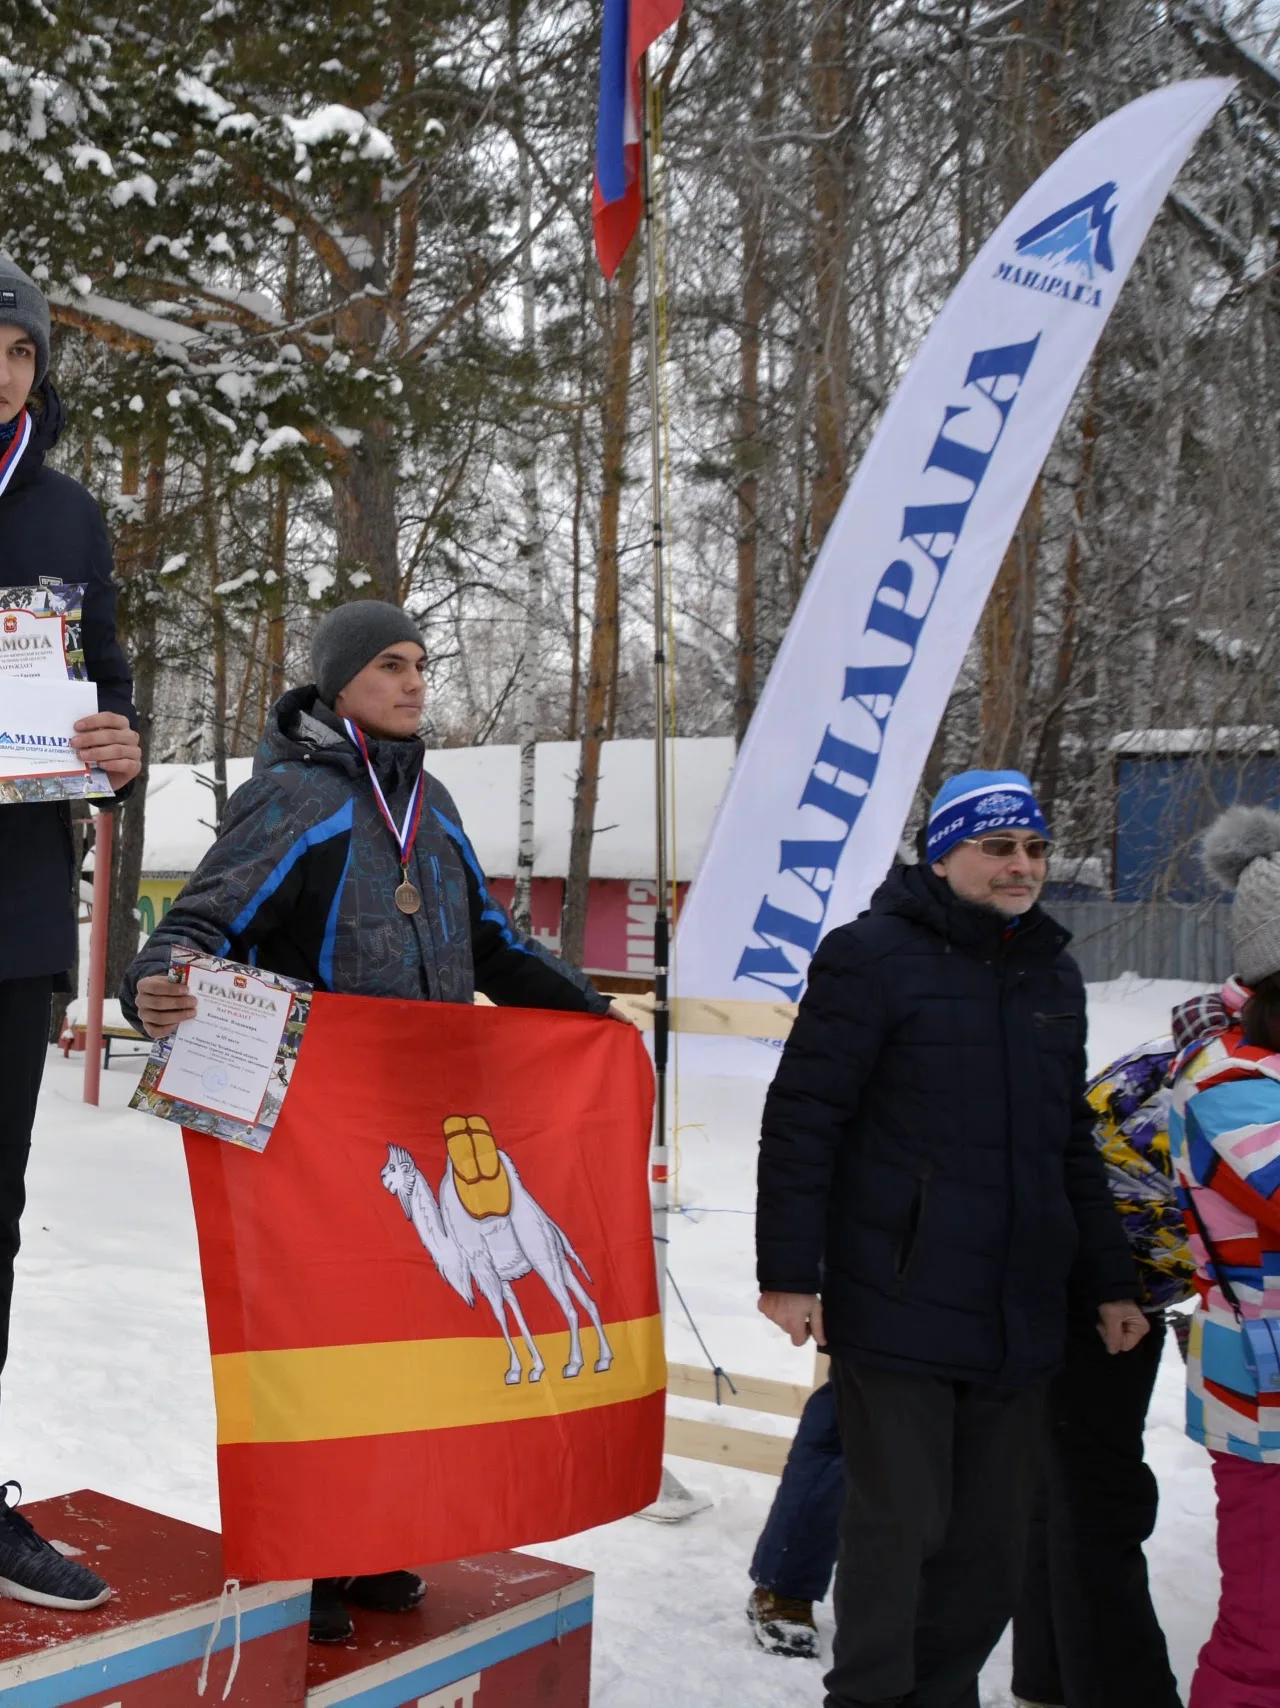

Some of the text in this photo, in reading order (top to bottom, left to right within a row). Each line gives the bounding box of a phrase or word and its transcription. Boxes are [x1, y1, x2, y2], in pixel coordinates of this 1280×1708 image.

[992, 262, 1102, 308] МАНАРАГА
[733, 330, 1042, 1004] МАНАРАГА
[972, 816, 1031, 832] 2014
[198, 981, 277, 1012] ГРАМОТА
